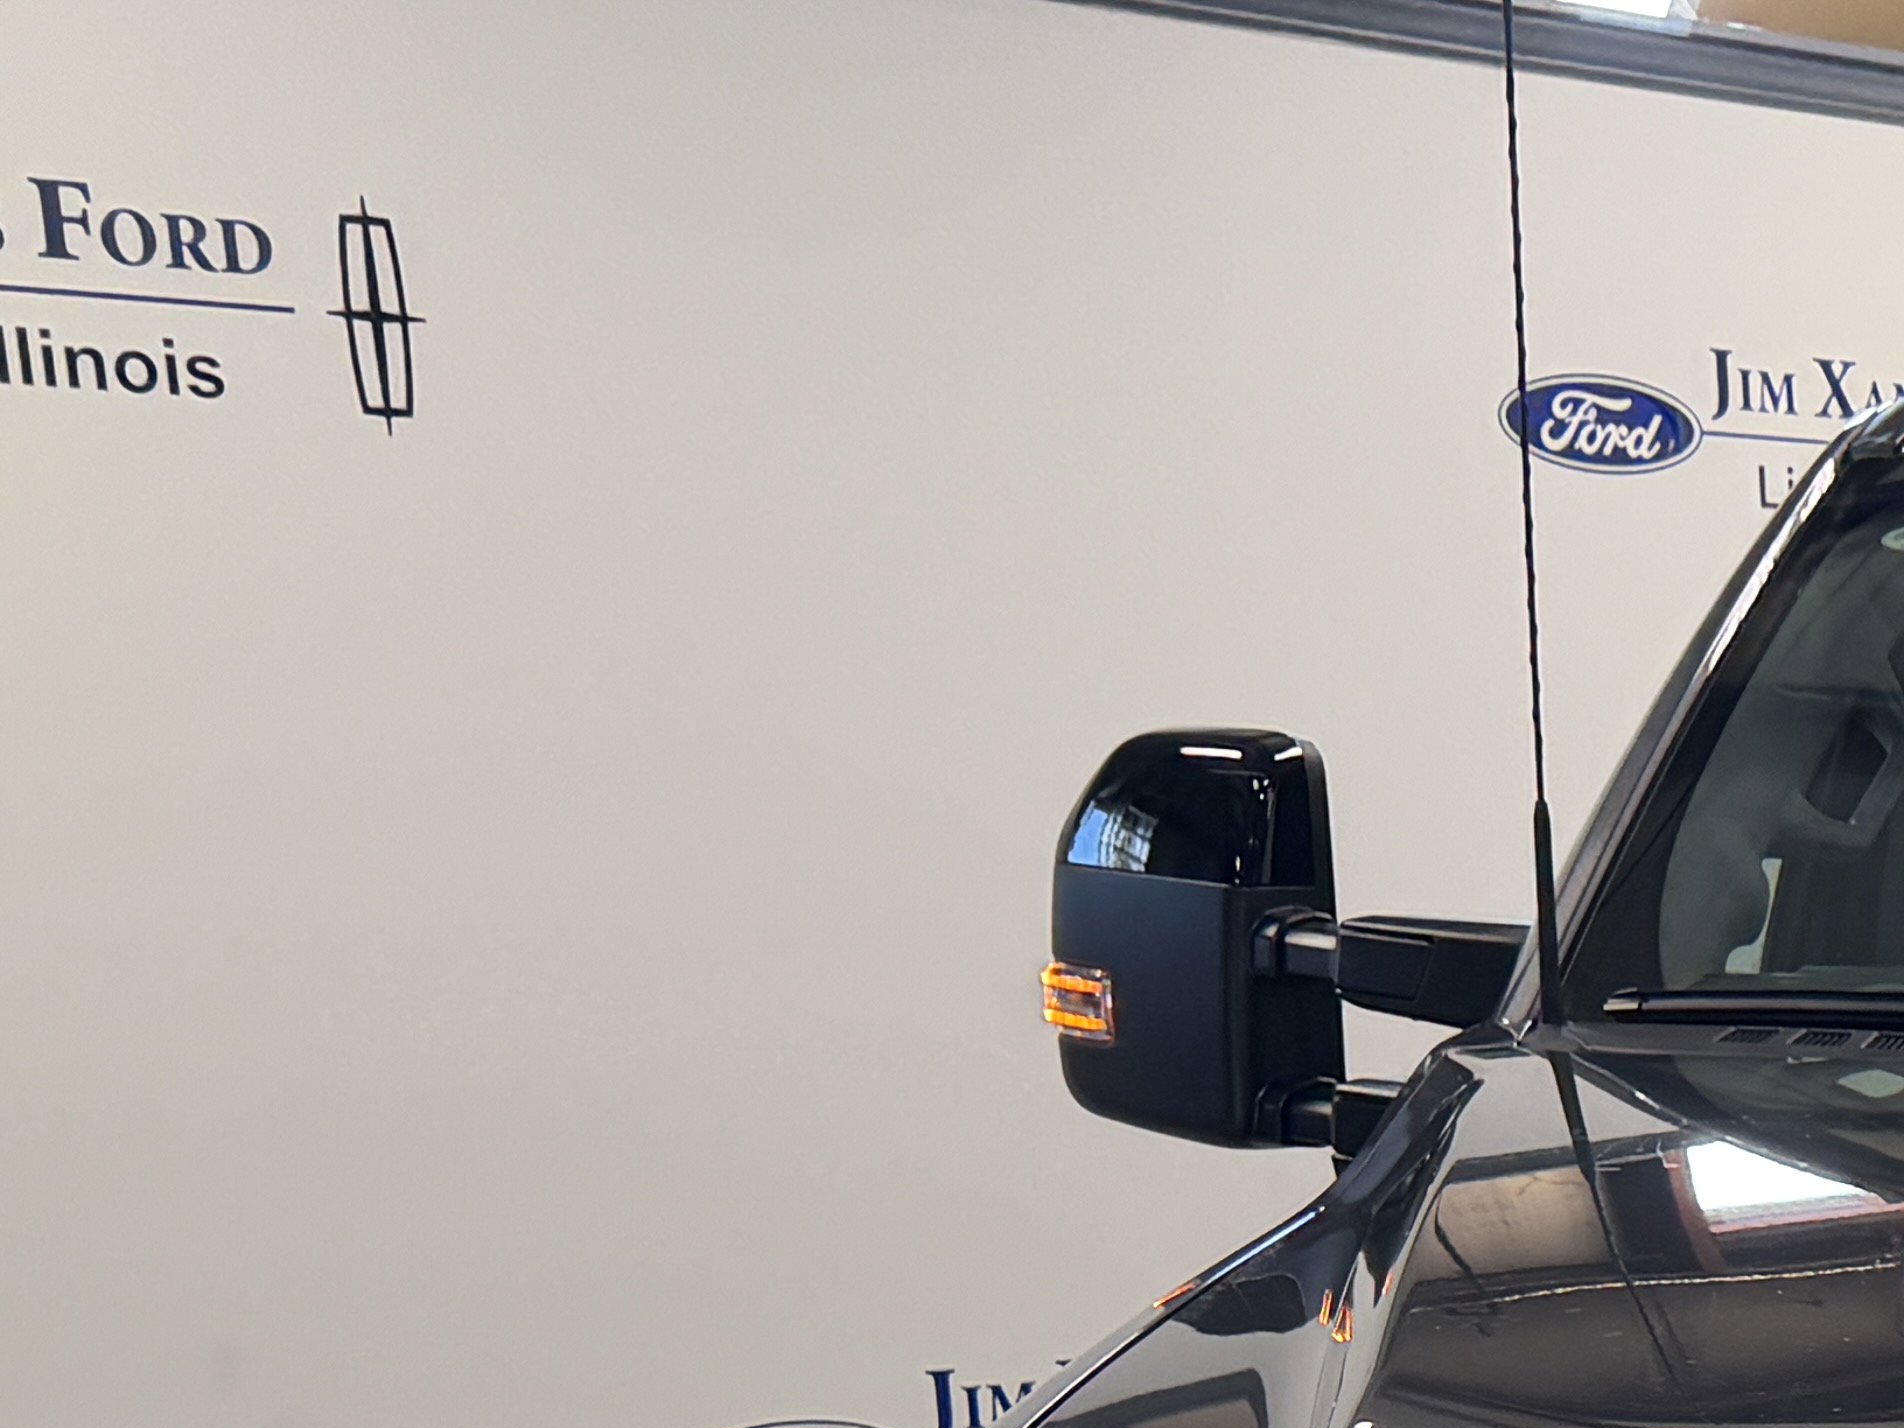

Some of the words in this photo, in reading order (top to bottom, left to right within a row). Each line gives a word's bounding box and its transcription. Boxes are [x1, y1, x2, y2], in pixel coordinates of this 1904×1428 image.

[27, 176, 273, 275] FORD
[1709, 347, 1800, 421] JIM
[1540, 389, 1664, 460] Ford
